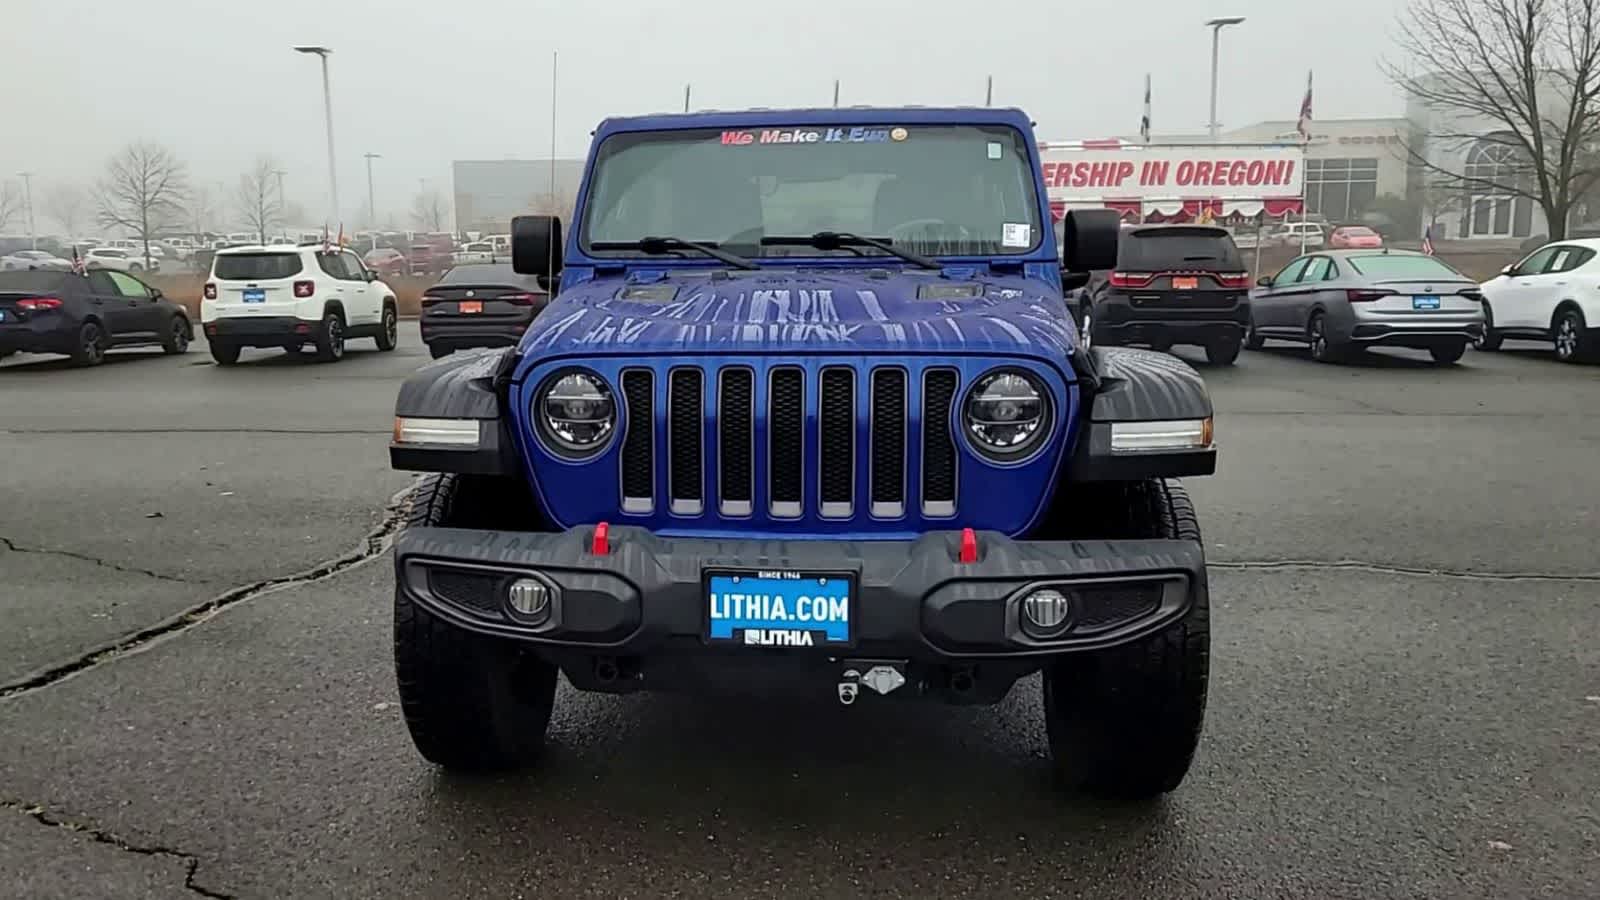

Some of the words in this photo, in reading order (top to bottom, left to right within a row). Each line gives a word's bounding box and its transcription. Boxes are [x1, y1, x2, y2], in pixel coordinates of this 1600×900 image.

[721, 130, 753, 145] We
[760, 129, 819, 143] Make
[825, 128, 843, 141] It
[1043, 162, 1133, 187] ERSHIP
[1139, 161, 1169, 186] IN
[1176, 159, 1295, 187] OREGON!
[710, 593, 849, 622] LITHIA.COM
[761, 630, 814, 646] LITHIA
